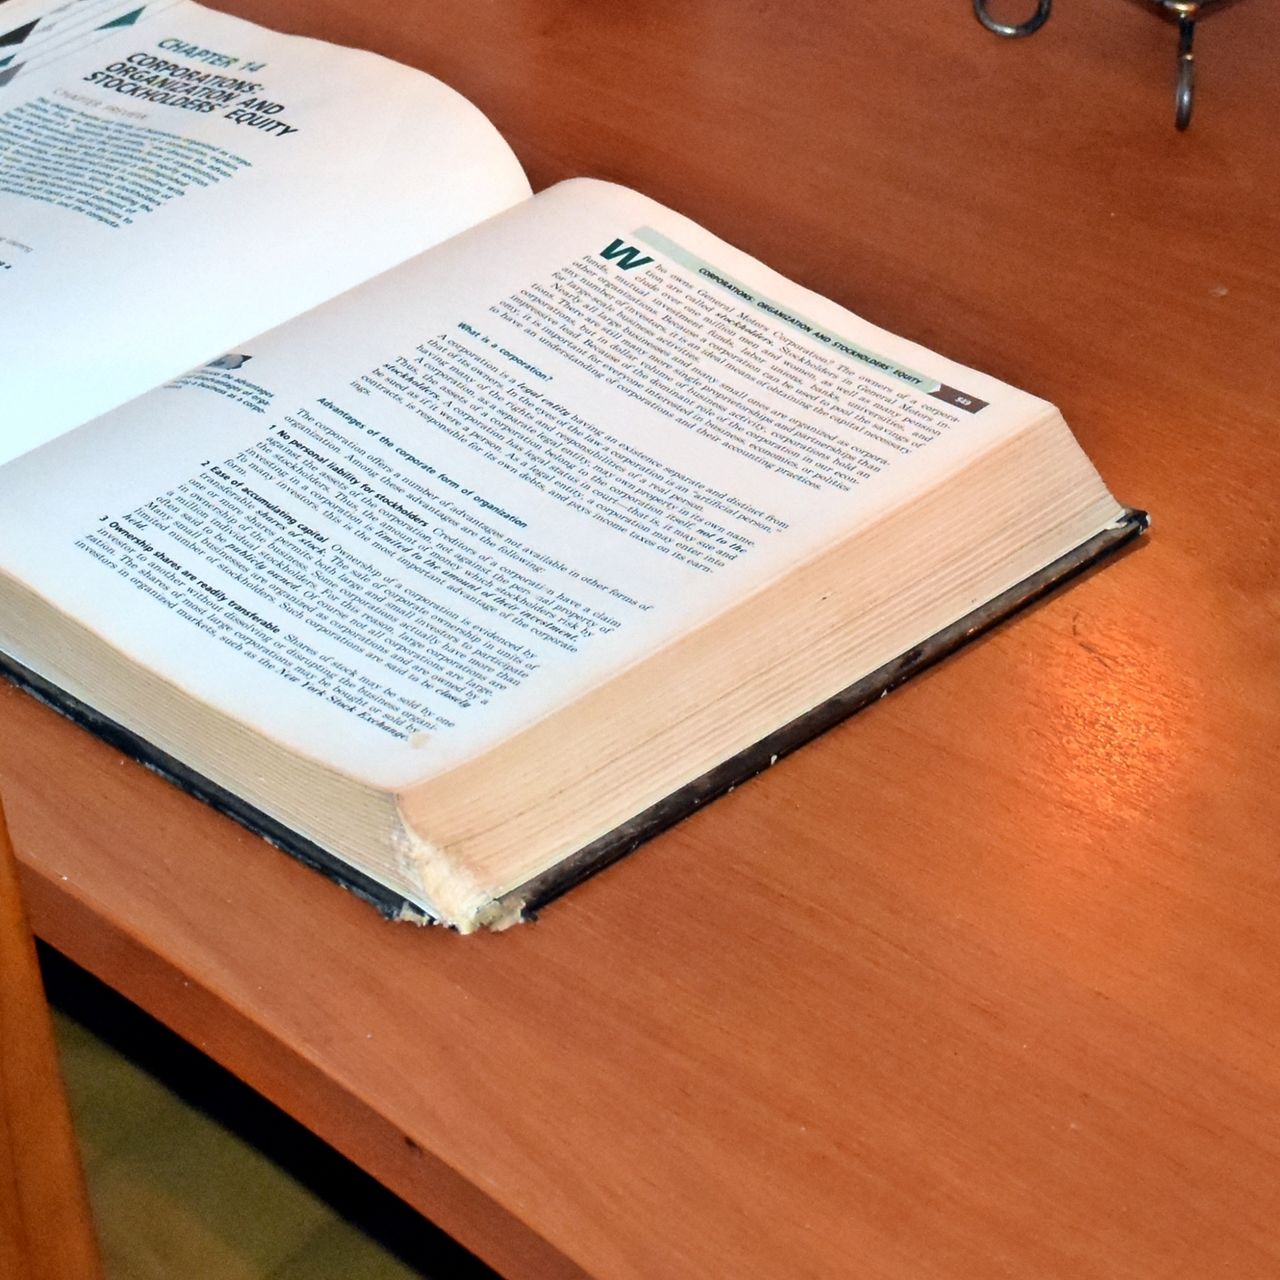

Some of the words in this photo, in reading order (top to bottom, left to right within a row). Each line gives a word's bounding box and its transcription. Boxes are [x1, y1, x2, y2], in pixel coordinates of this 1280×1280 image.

[104, 61, 237, 105] ORGANIZATION
[241, 97, 286, 116] AND
[125, 52, 264, 94] CORPORATIONS:
[157, 38, 238, 68] CHAPTER
[224, 108, 298, 137] EQUITY
[457, 321, 481, 337] What
[480, 335, 490, 343] is
[498, 347, 553, 381] corporation?
[654, 263, 667, 274] he
[669, 273, 693, 289] owns
[696, 288, 735, 312] General
[736, 311, 769, 331] Motors
[772, 330, 835, 364] Corporation?
[836, 363, 855, 375] The
[857, 375, 893, 393] owners
[920, 403, 960, 422] corpora-
[698, 267, 754, 302] CORPORATIONS:
[756, 301, 812, 332] ORGANIZATION
[811, 331, 831, 343] AND
[831, 341, 893, 370] STOCKHOLDERS'
[892, 369, 922, 384] EQUITY
[276, 429, 290, 440] No
[287, 439, 329, 464] personal
[326, 461, 360, 485] liability
[360, 482, 375, 493] for
[374, 493, 428, 527] stockholders
[283, 415, 340, 454] organization.
[343, 453, 379, 478] Among
[379, 475, 405, 493] these
[405, 493, 459, 526] advantages
[459, 525, 478, 536] are
[478, 535, 496, 547] the
[496, 545, 545, 573] following:
[316, 397, 365, 429] Advantages
[366, 428, 380, 436] of
[378, 435, 394, 447] the
[394, 447, 436, 474] corporate
[436, 473, 460, 489] form
[460, 488, 474, 496] of
[472, 495, 527, 528] organization
[446, 339, 498, 373] corporation
[498, 370, 509, 379] is
[516, 381, 544, 399] legal
[540, 398, 570, 416] entity
[569, 413, 604, 437] having
[603, 434, 618, 444] an
[617, 442, 663, 467] existence
[662, 466, 705, 489] separate
[705, 487, 728, 499] and
[725, 496, 765, 517] distinct
[764, 514, 789, 529] from
[209, 465, 230, 480] Ease
[229, 479, 244, 487] of
[240, 487, 297, 525] accumulating
[296, 523, 329, 543] capital
[330, 543, 382, 577] Ownership
[403, 588, 459, 619] corporation
[459, 616, 472, 626] is
[471, 624, 524, 651] evidenced
[521, 648, 537, 659] by
[296, 407, 315, 421] The
[314, 421, 366, 455] corporation
[366, 454, 393, 473] offers
[400, 476, 439, 500] number
[438, 499, 454, 507] of
[449, 506, 504, 538] advantages
[503, 536, 523, 548] not
[521, 547, 567, 571] available
[567, 569, 580, 578] in
[580, 576, 609, 591] other
[608, 588, 638, 605] forms
[637, 603, 654, 611] of
[108, 521, 153, 552] Ownership
[153, 550, 181, 570] shares
[181, 569, 197, 580] are
[196, 580, 228, 601] readily
[229, 599, 280, 633] transferable
[283, 633, 317, 655] Shares
[318, 654, 335, 662] of
[330, 661, 357, 677] stock
[357, 675, 382, 689] may
[382, 687, 396, 697] be
[396, 696, 422, 709] sold
[419, 706, 435, 717] by
[434, 715, 455, 727] one
[155, 496, 180, 513] often
[179, 512, 204, 527] said
[201, 525, 213, 534] to
[213, 532, 227, 543] be
[224, 543, 266, 570] publicly
[266, 569, 302, 592] owned.
[302, 590, 320, 600] Of
[316, 599, 349, 618] course
[348, 617, 368, 629] not
[367, 628, 386, 638] all
[383, 637, 444, 671] corporations
[444, 669, 464, 680] are
[464, 677, 493, 696] large.
